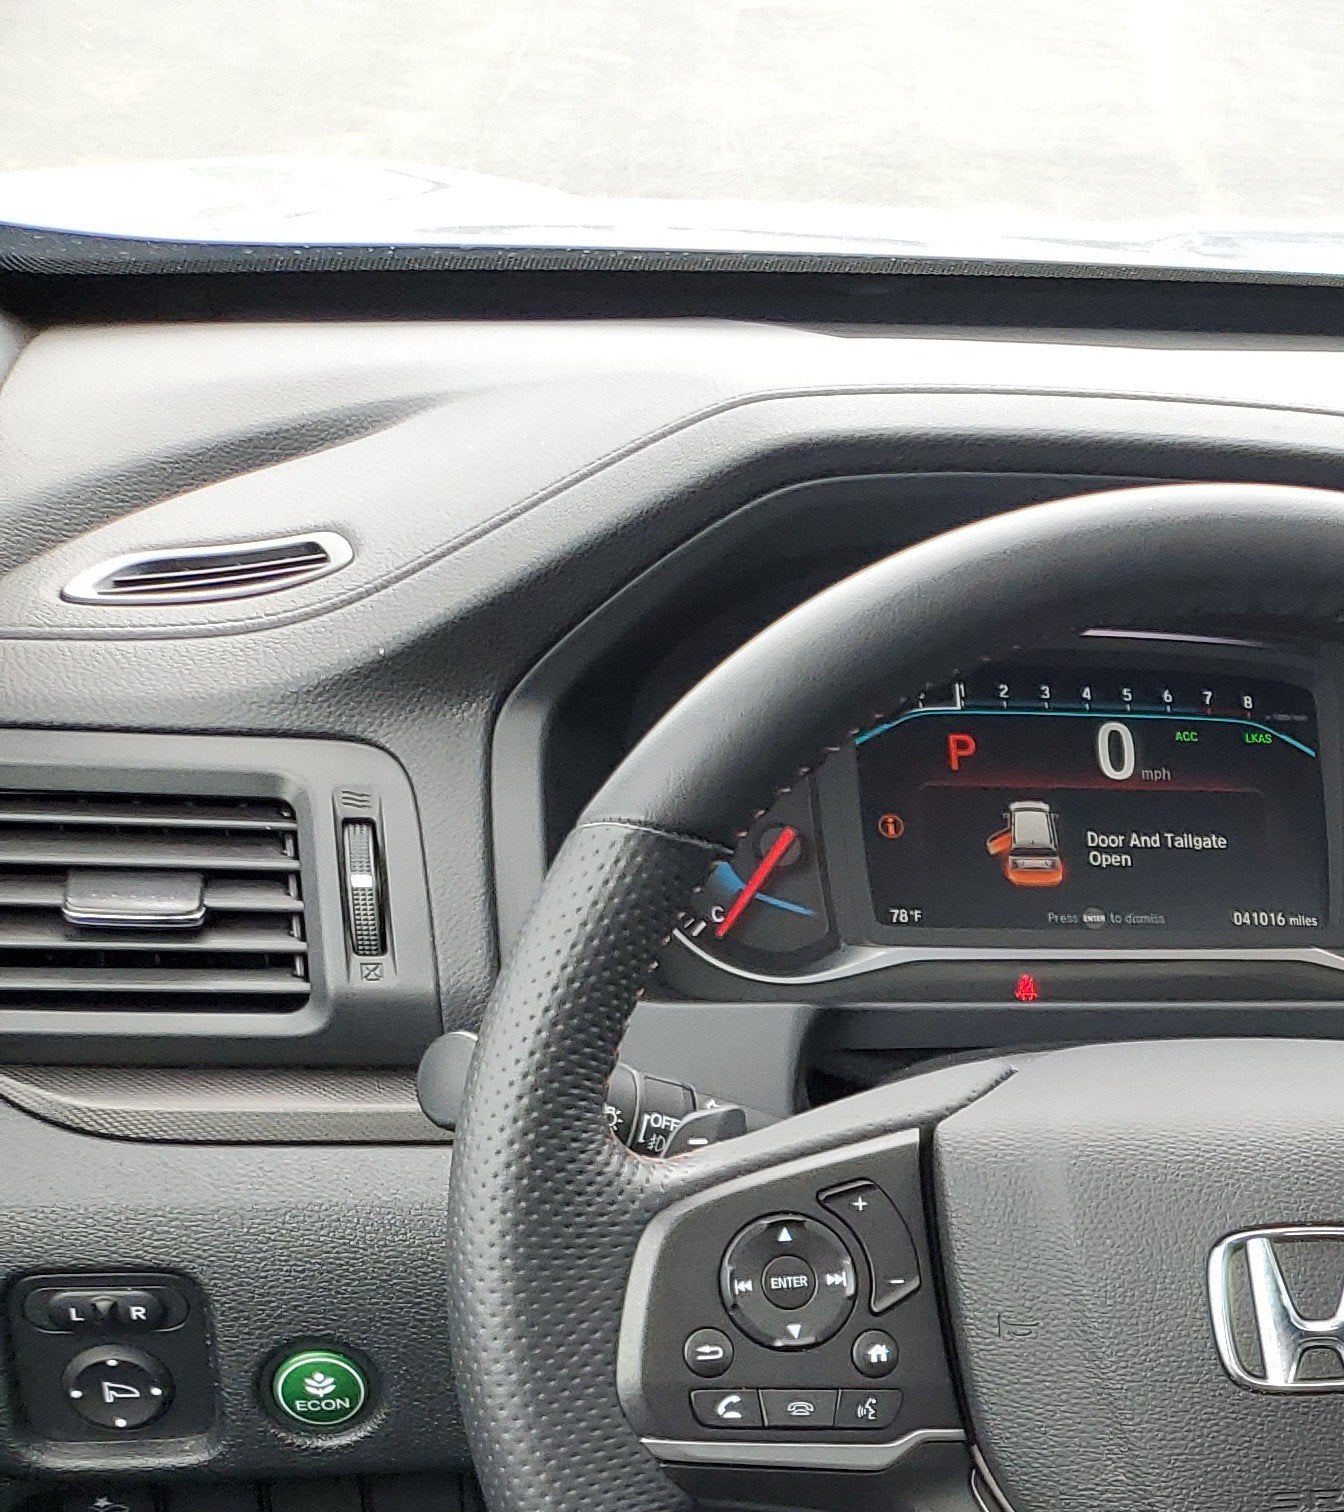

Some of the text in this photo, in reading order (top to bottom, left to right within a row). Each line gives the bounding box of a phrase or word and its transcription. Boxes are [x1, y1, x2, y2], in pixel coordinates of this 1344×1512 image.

[999, 684, 1009, 698] 2
[1040, 685, 1050, 699] 3
[1082, 686, 1091, 700] 4
[1122, 688, 1132, 701] 5
[1163, 689, 1173, 702] 6
[1203, 691, 1213, 705] 7
[1243, 695, 1253, 709] 8
[1175, 731, 1199, 742] ACC
[1245, 733, 1273, 744] LKAS
[948, 733, 976, 771] P
[1098, 721, 1171, 782] 0 mph
[1086, 831, 1227, 850] Door And Tailgate
[1089, 851, 1132, 868] Open
[890, 909, 922, 923] 78°F
[1048, 912, 1078, 923] Press
[1110, 912, 1122, 923] to
[1233, 911, 1319, 926] 041016 miles
[770, 1274, 808, 1289] ENTER
[69, 1307, 84, 1322] L
[130, 1306, 147, 1320] R
[295, 1398, 350, 1412] ECON
